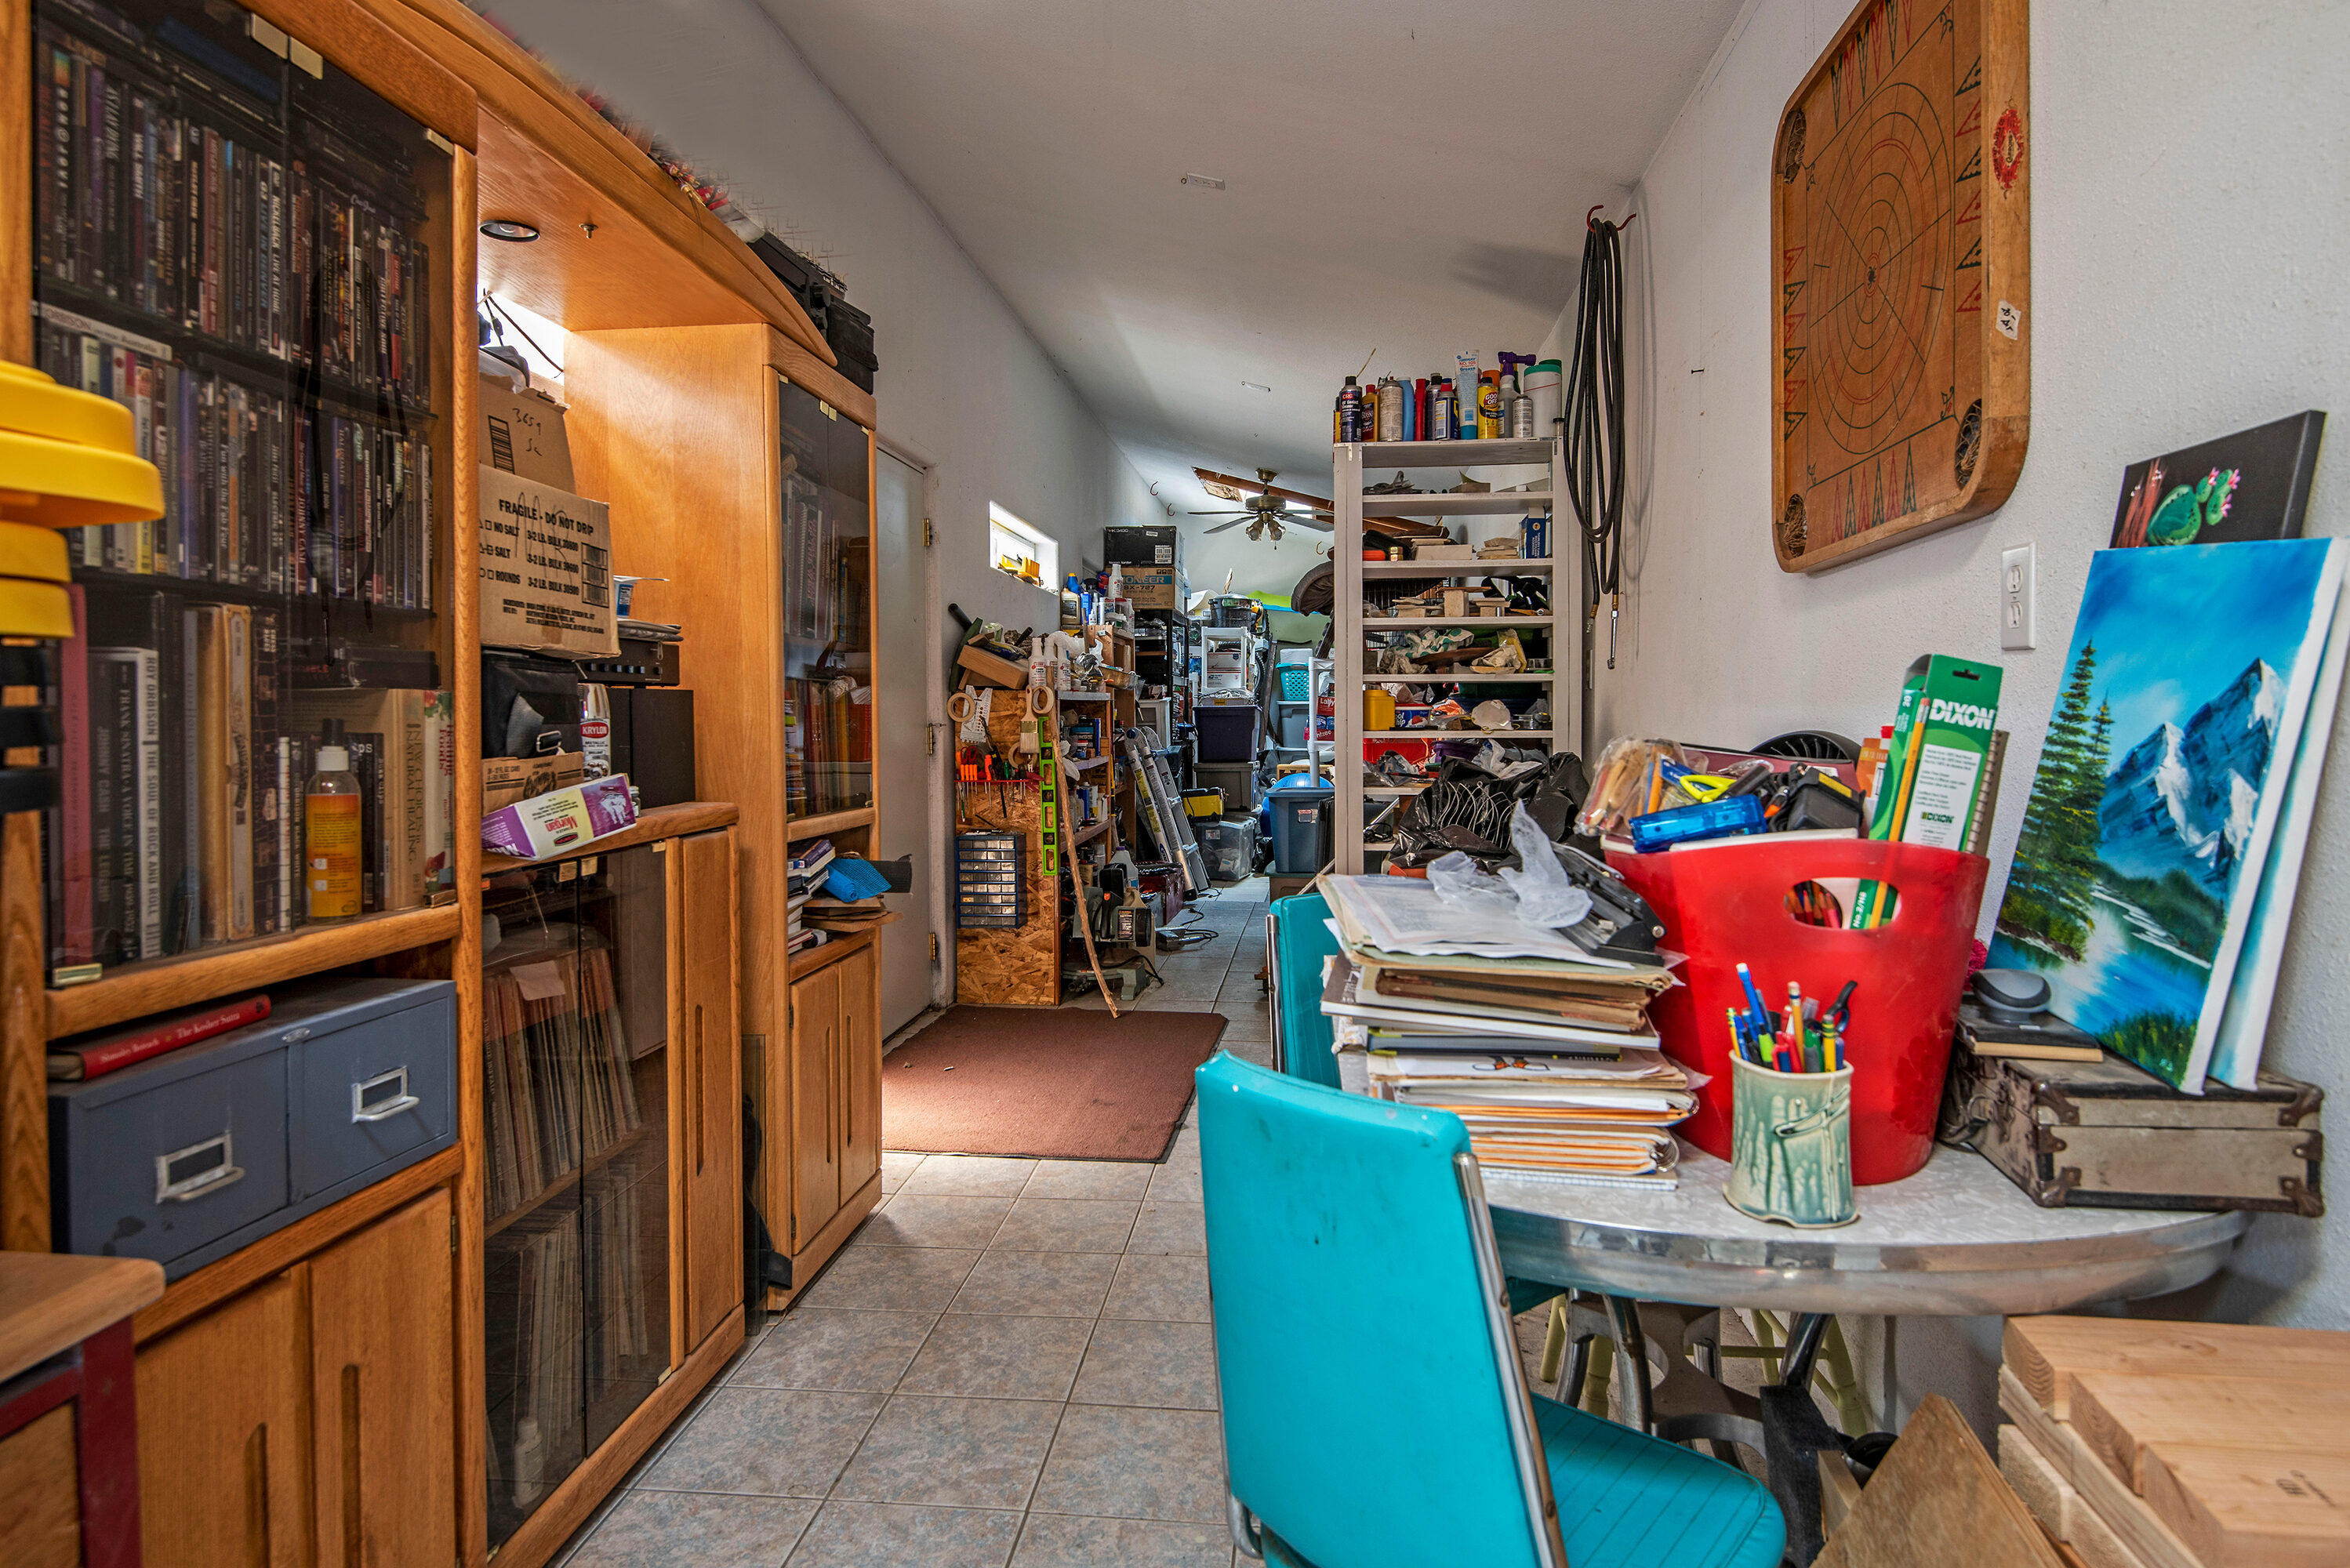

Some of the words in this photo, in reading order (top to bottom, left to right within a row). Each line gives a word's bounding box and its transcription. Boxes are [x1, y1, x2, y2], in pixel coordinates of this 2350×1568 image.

[133, 133, 143, 159] WILL
[133, 162, 143, 199] SMITH
[260, 181, 267, 201] G3
[271, 195, 281, 249] NICKELBACK
[260, 235, 267, 250] IN
[272, 254, 281, 274] LIVE
[272, 277, 280, 285] AT
[220, 444, 229, 463] Fun
[499, 499, 538, 521] FRAGILE
[545, 512, 557, 525] DO
[559, 515, 574, 531] NOT
[220, 527, 229, 549] Four
[494, 521, 503, 533] NO
[504, 524, 520, 538] SALT
[547, 535, 562, 547] BULK
[495, 546, 511, 559] SALT
[548, 557, 562, 570] BULK
[496, 570, 521, 585] ROUNDS
[549, 580, 562, 592] BULK
[146, 657, 157, 681] ROY
[119, 689, 132, 728] FRANK
[147, 684, 157, 736] ORBISON
[1928, 698, 1997, 731] DIXON
[583, 725, 608, 735] KRYLON
[97, 727, 111, 775] JOHNNY
[119, 731, 133, 779] SINATRA
[147, 750, 158, 772] THE
[413, 731, 422, 767] NEW
[438, 728, 446, 771] Foods
[406, 731, 415, 794] NATURAL
[98, 779, 110, 813] CASH
[147, 775, 158, 803] SOUL
[122, 796, 133, 829] VOICE
[413, 771, 423, 833] CHOICES
[147, 808, 158, 822] OF
[545, 815, 578, 833] Morgan
[1927, 812, 1955, 824] DIXON
[98, 828, 111, 850] THE
[122, 833, 133, 848] IN
[147, 826, 158, 857] ROCK
[122, 851, 133, 876] TIME
[147, 861, 158, 884] AND
[98, 855, 111, 902] LEGEND
[147, 887, 158, 917] ROLL
[176, 1025, 193, 1039] The
[194, 1019, 220, 1034] Kosher
[220, 1012, 241, 1024] Sutra
